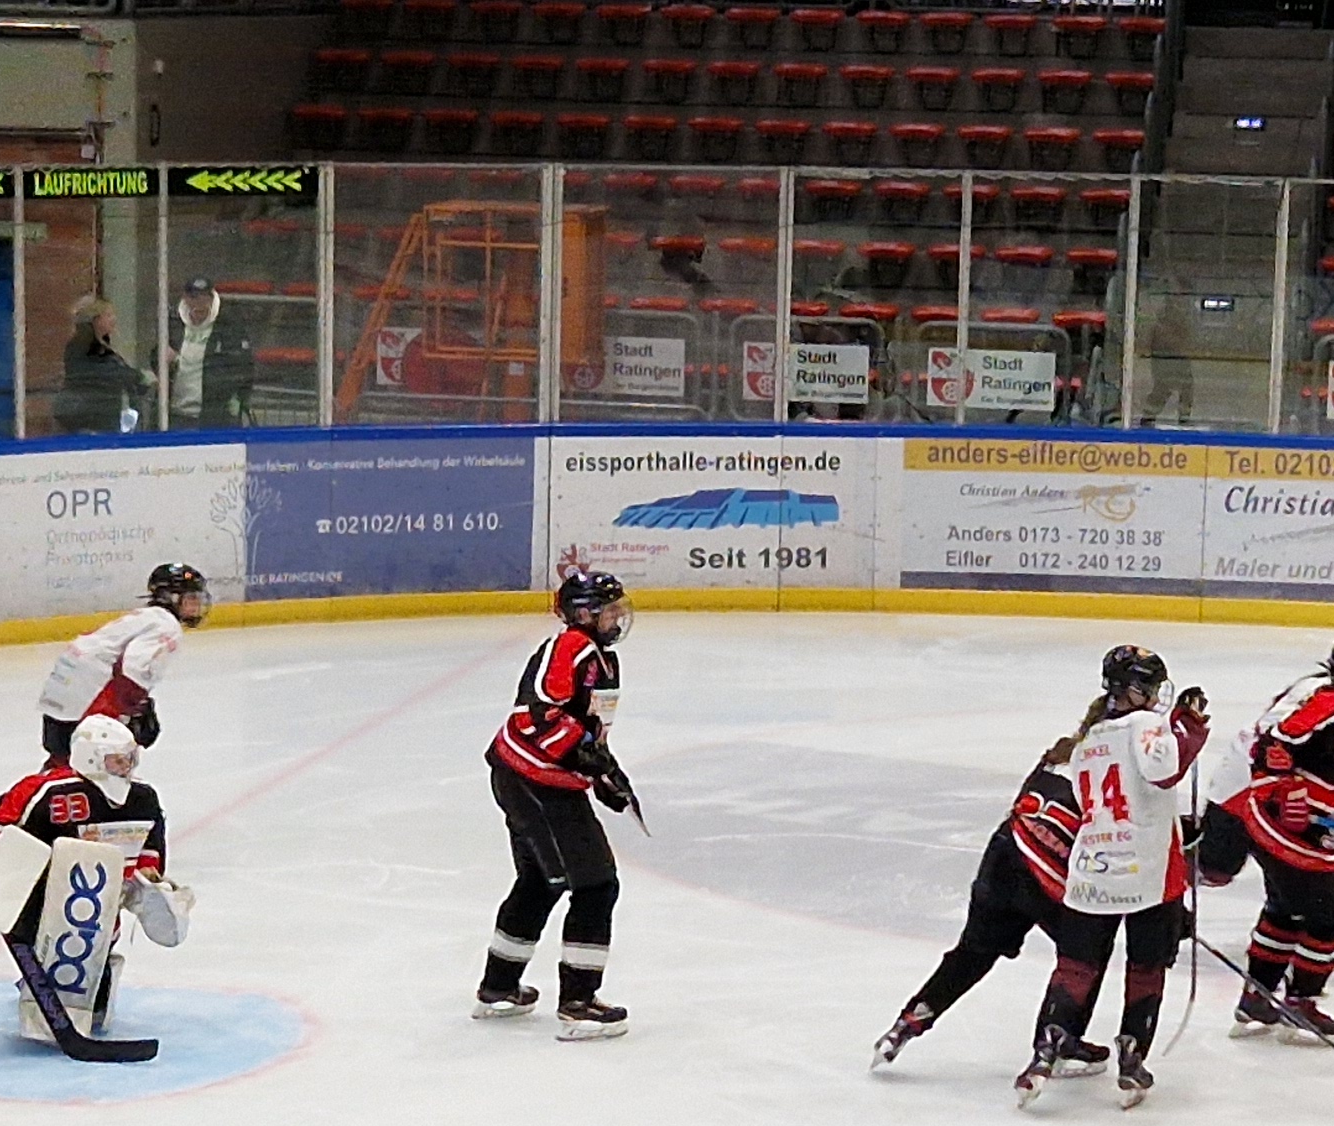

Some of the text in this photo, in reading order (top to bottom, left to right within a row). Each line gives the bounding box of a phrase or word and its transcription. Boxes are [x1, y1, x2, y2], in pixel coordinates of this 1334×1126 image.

[33, 171, 147, 197] LAUFRICHTUNG
[613, 343, 654, 357] Stadt
[796, 350, 837, 364] Stadt
[613, 362, 681, 380] Ratingen
[982, 355, 1023, 371] Stadt
[796, 370, 866, 388] Ratingen
[981, 376, 1051, 394] Ratingen
[565, 450, 841, 477] eissporthalle-ratingen.de
[927, 442, 1188, 473] anders-eifler@web.de
[1224, 451, 1265, 475] Tel.
[46, 488, 112, 519] OPR
[335, 513, 427, 535] 02102/14
[433, 513, 454, 531] 81
[947, 525, 1012, 542] Anders
[1018, 526, 1060, 543] 0173
[1078, 528, 1109, 545] 720
[1115, 529, 1136, 546] 38
[688, 546, 829, 569] Seit 1981
[945, 550, 993, 567] Eifler
[1018, 552, 1060, 568] 0172
[1078, 552, 1109, 570] 240
[1115, 553, 1137, 571] 12
[1141, 554, 1162, 572] 29
[1288, 561, 1332, 581] und
[50, 793, 91, 824] 33
